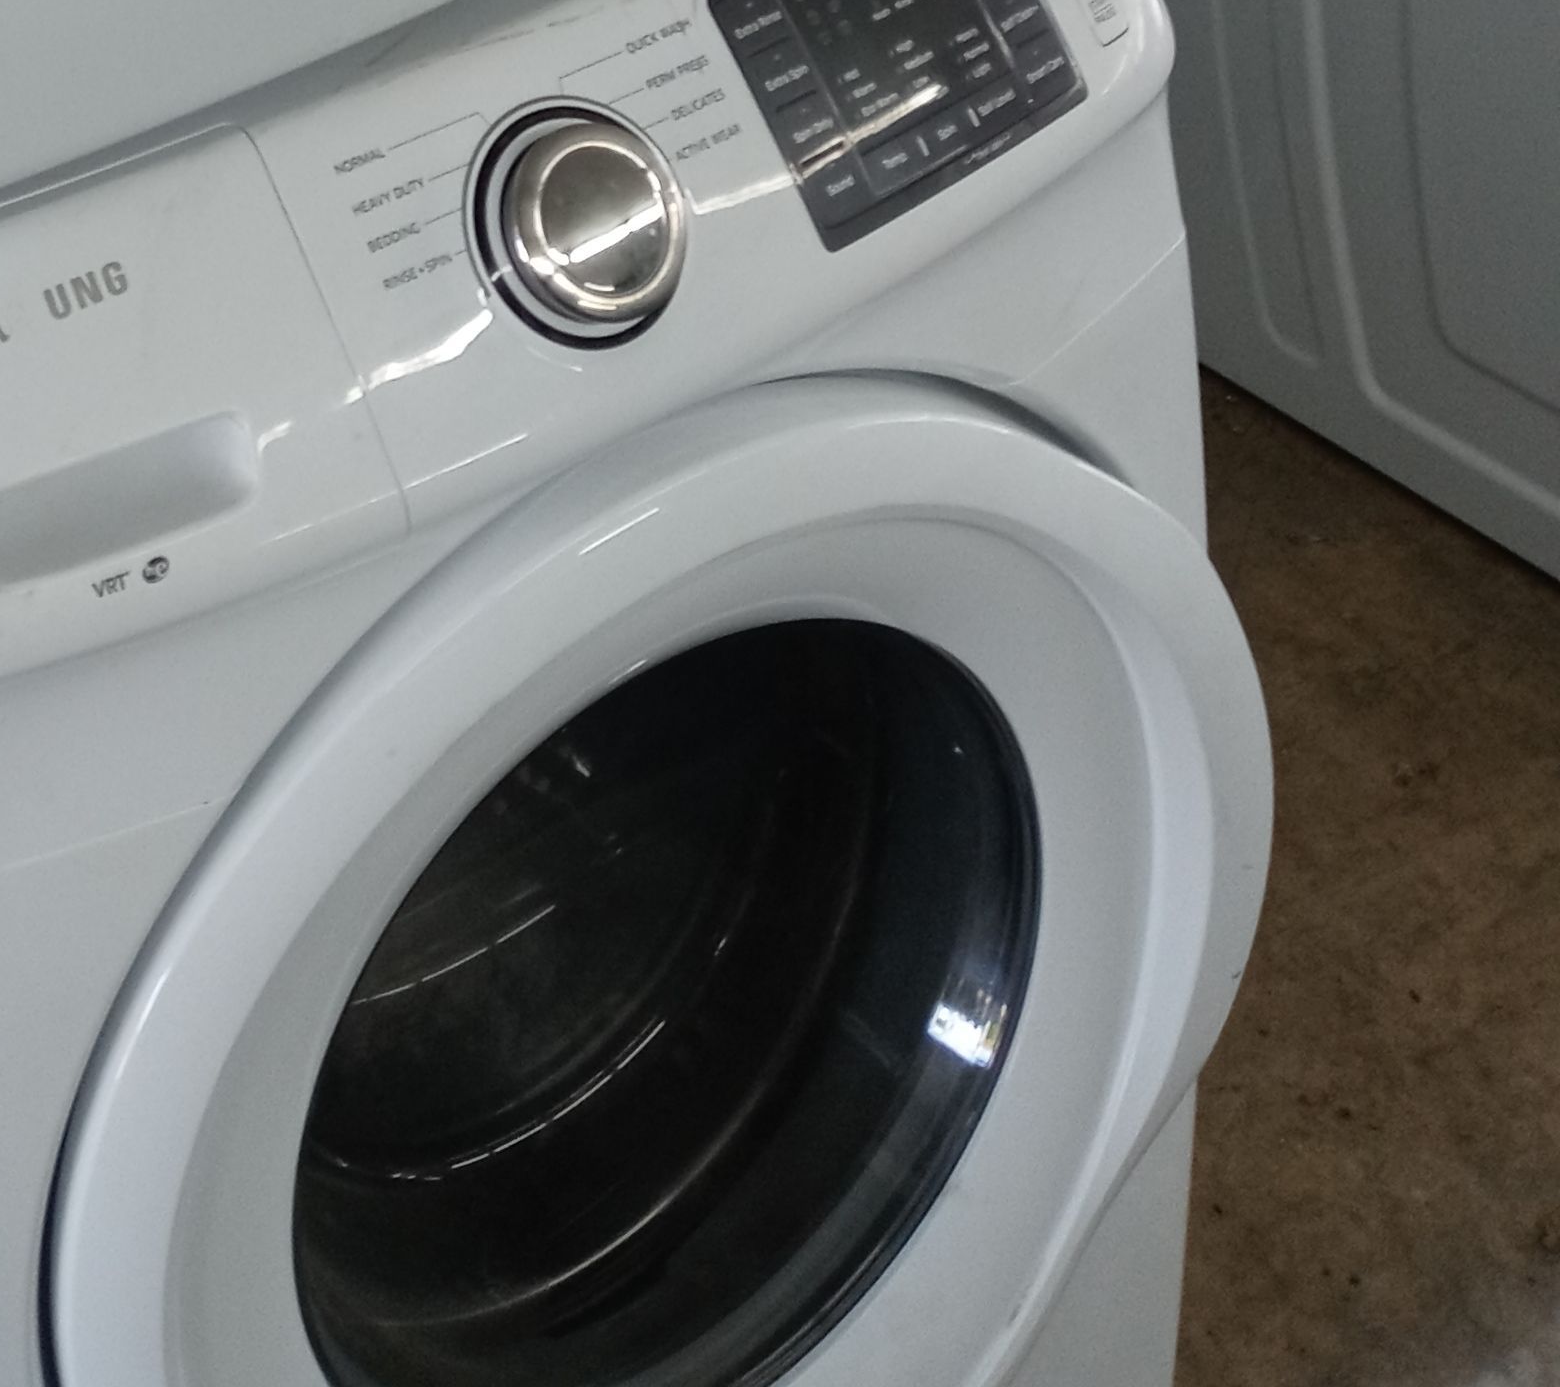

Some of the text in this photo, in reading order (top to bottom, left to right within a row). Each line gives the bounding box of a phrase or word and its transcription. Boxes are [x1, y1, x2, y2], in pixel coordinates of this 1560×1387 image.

[626, 32, 659, 54] QUICK
[671, 87, 726, 121] DELICATES
[333, 147, 386, 173] NORMAL
[676, 137, 711, 160] ACTIVE
[352, 177, 424, 215] HEAVY DUTY
[367, 221, 421, 253] BEDDING
[91, 569, 131, 599] VRT
